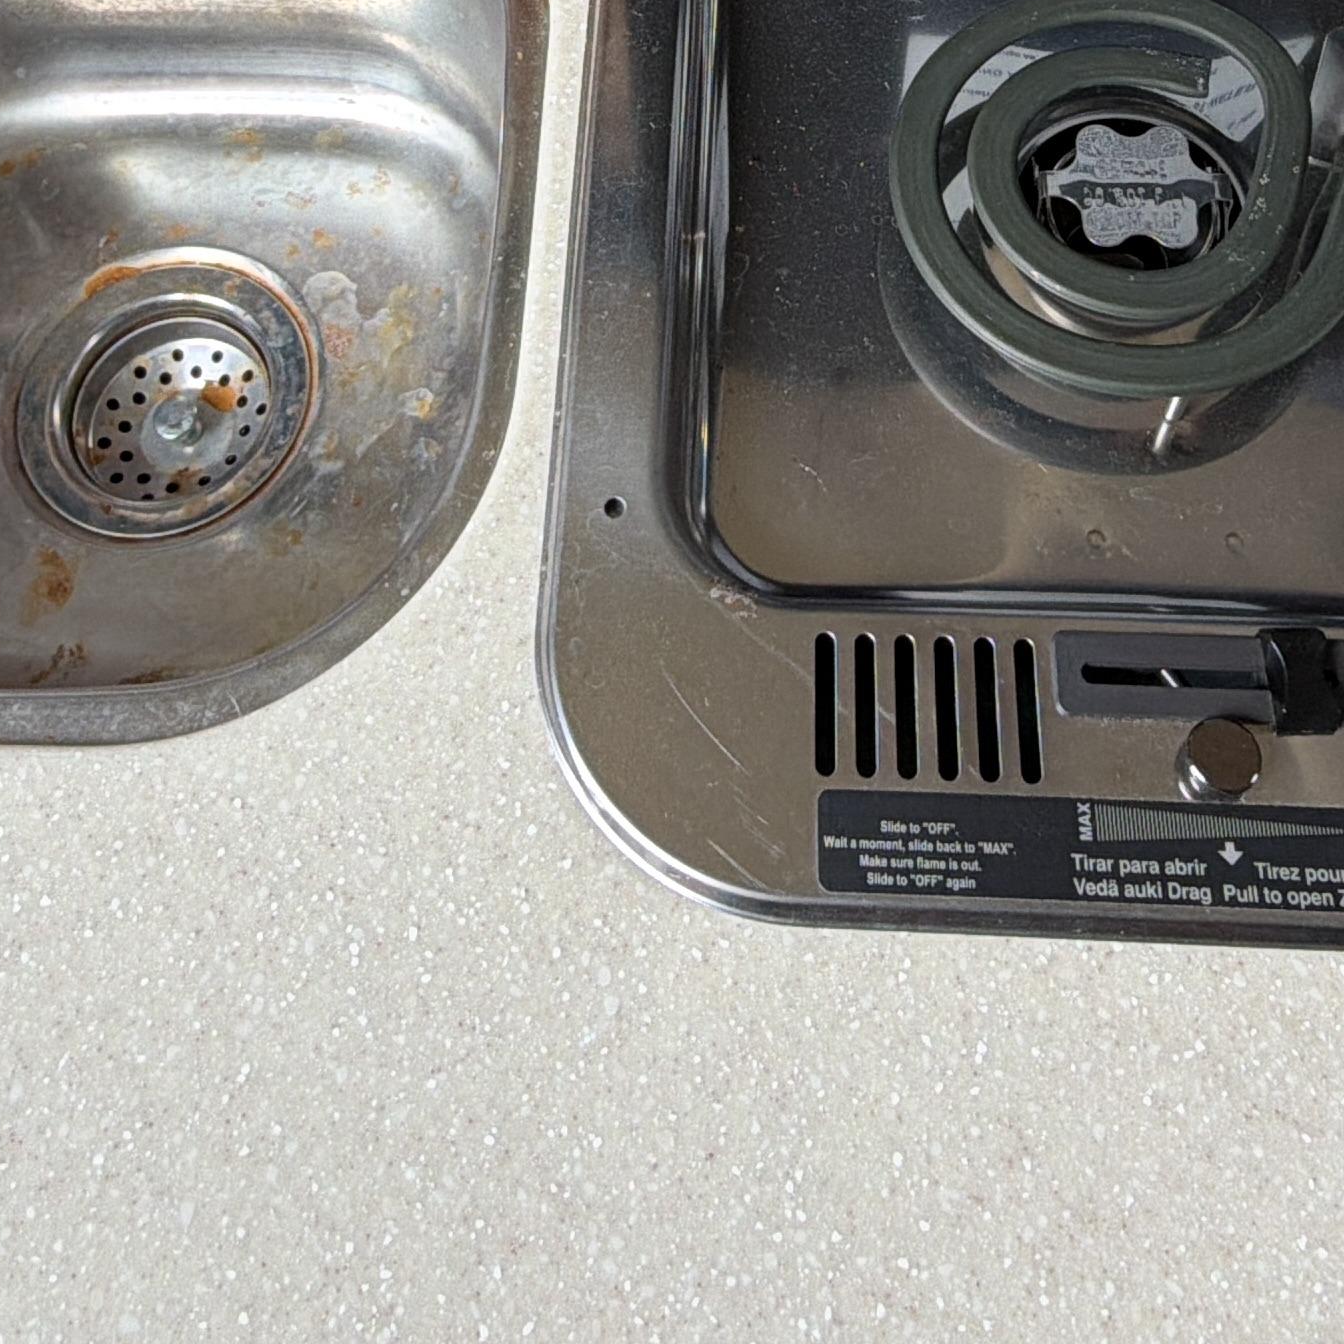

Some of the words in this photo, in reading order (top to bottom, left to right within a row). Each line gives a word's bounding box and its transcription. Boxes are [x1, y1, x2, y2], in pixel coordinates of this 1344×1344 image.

[880, 819, 907, 833] Slide
[908, 822, 921, 834] to
[1079, 802, 1093, 842] MAX
[823, 835, 848, 848] Wait
[849, 838, 857, 849] a
[907, 838, 934, 852] slide
[935, 840, 962, 853] back
[963, 841, 976, 854] to
[858, 853, 888, 867] Make
[889, 857, 914, 869] sure
[916, 856, 946, 870] flame
[948, 857, 959, 871] is
[1070, 852, 1114, 872] Tirar
[1118, 859, 1160, 877] para
[1164, 858, 1207, 876] abrir
[1253, 861, 1301, 881] Tirez
[866, 871, 894, 886] Slide
[895, 873, 908, 886] to
[909, 873, 943, 887] "OFF"
[945, 876, 976, 891] again
[1073, 877, 1119, 897] Vedä
[1123, 880, 1163, 898] auki
[1167, 881, 1212, 905] Drag
[1222, 883, 1259, 903] Pull
[1262, 886, 1283, 904] to
[1286, 890, 1334, 908] open
